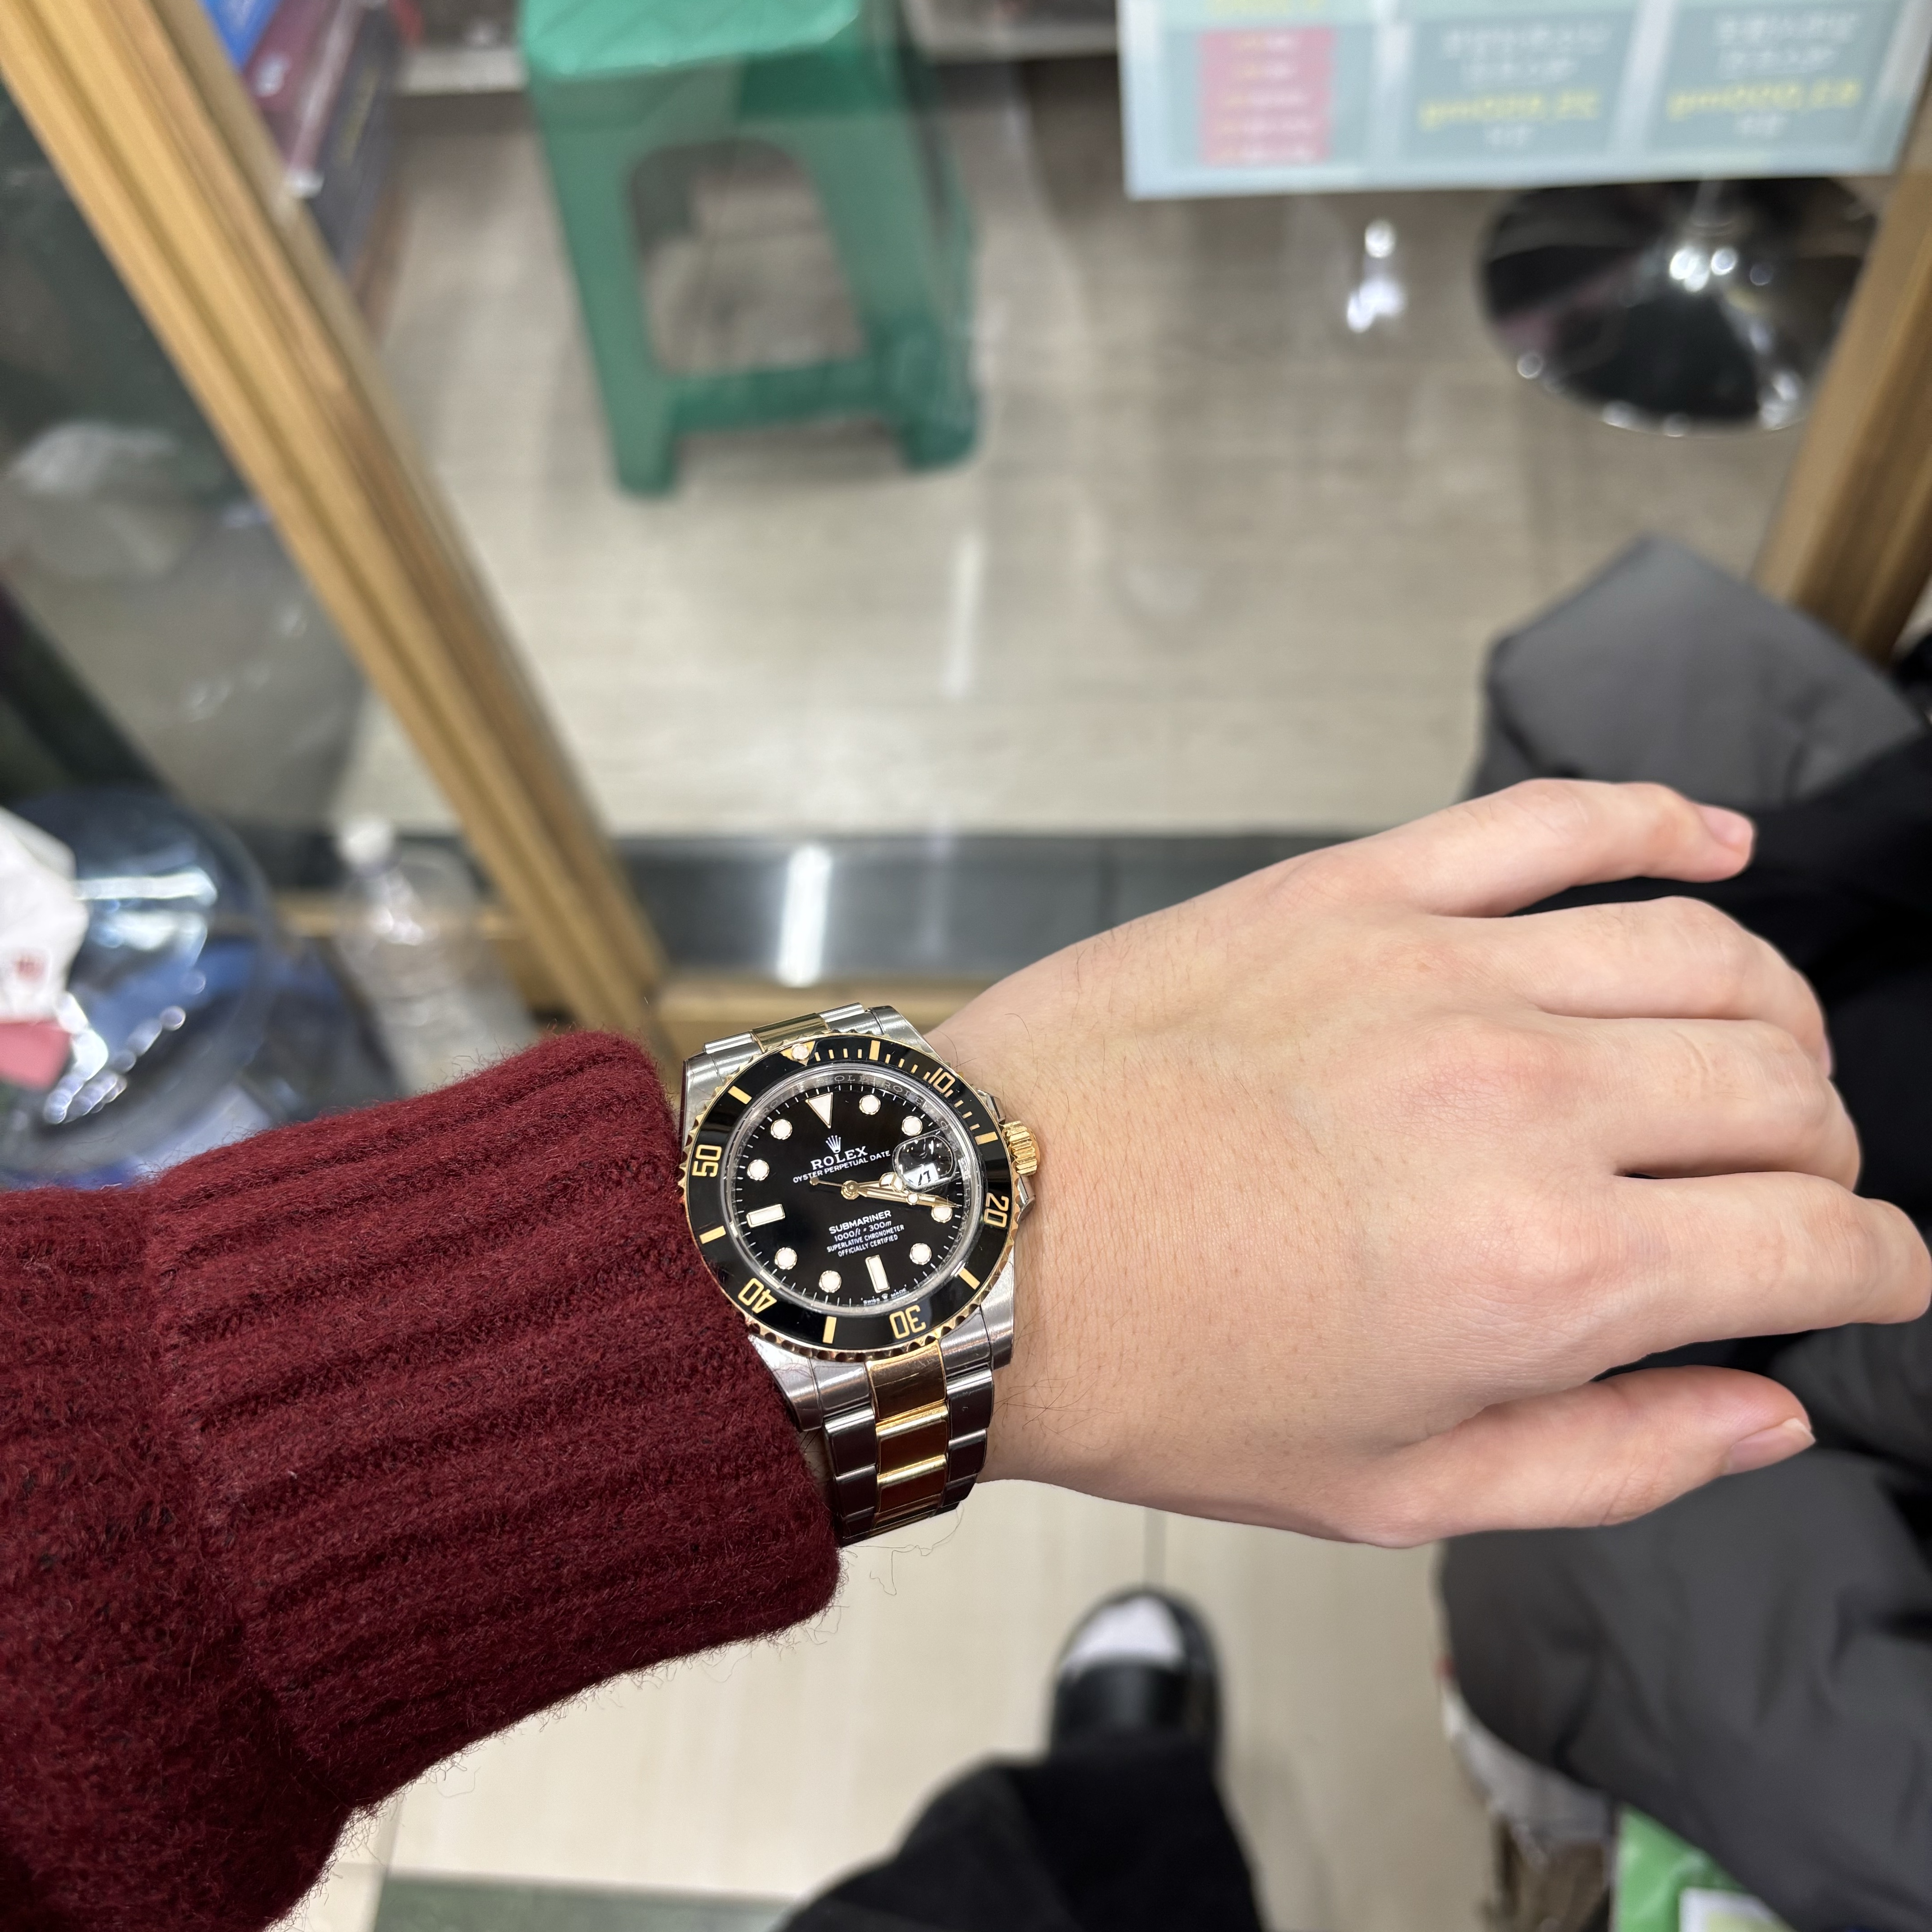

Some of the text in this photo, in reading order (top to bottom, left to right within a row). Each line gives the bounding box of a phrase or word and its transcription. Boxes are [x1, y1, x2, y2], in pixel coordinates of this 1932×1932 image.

[929, 1067, 955, 1094] 10
[692, 1145, 722, 1177] 50
[793, 1150, 891, 1183] OYSTER PERPETUAL DATE
[810, 1146, 868, 1170] ROLEX
[828, 1210, 892, 1234] SUBMARINER
[984, 1192, 1009, 1228] 20
[827, 1224, 905, 1253] SUPERLATIVE CHRONOMETER
[869, 1220, 892, 1232] 300m
[838, 1234, 898, 1257] OFFICIALLY CERTIFIED
[738, 1278, 777, 1314] 40
[889, 1305, 926, 1339] 30
